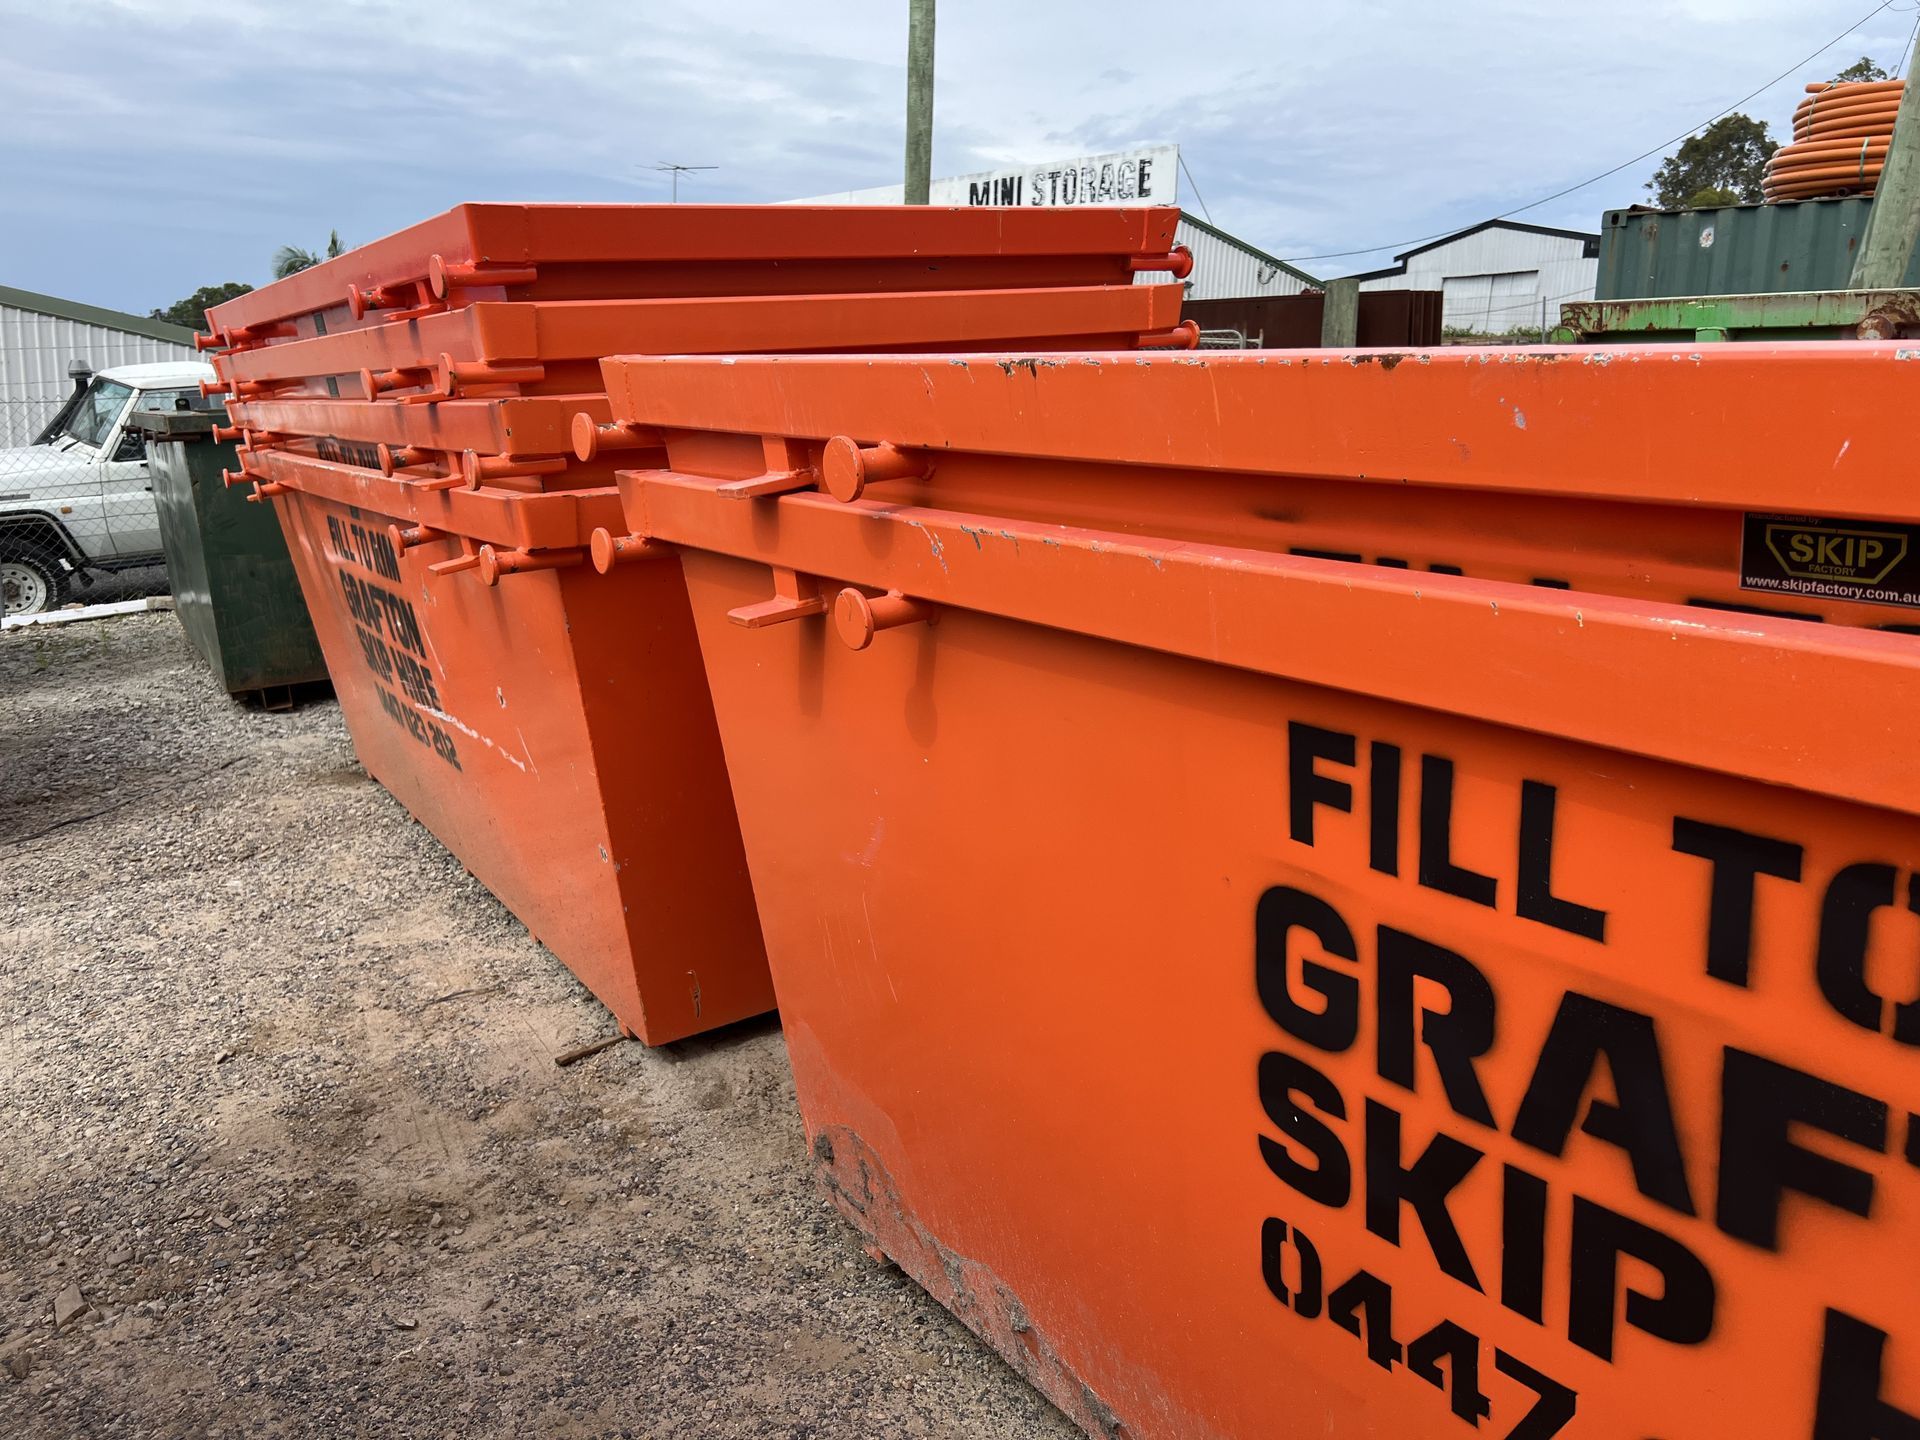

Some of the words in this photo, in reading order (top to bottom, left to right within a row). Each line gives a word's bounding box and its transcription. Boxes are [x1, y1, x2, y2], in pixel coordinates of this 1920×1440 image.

[969, 176, 1023, 206] MINI
[1031, 158, 1153, 206] STORAGE
[327, 514, 356, 563] FILL
[351, 523, 373, 572] TO
[1789, 534, 1884, 568] SKIP
[1808, 564, 1856, 576] FACTORY
[339, 568, 427, 661] GRAFTON
[1745, 576, 1920, 605] www.skipfactory.com.au
[355, 623, 394, 686] SKIP
[1288, 720, 1608, 945] FILL
[1672, 816, 1920, 1048] TO
[1256, 886, 1920, 1253] GRAF
[1258, 1051, 1718, 1365] SKIP
[1261, 1216, 1579, 1440] 0447
